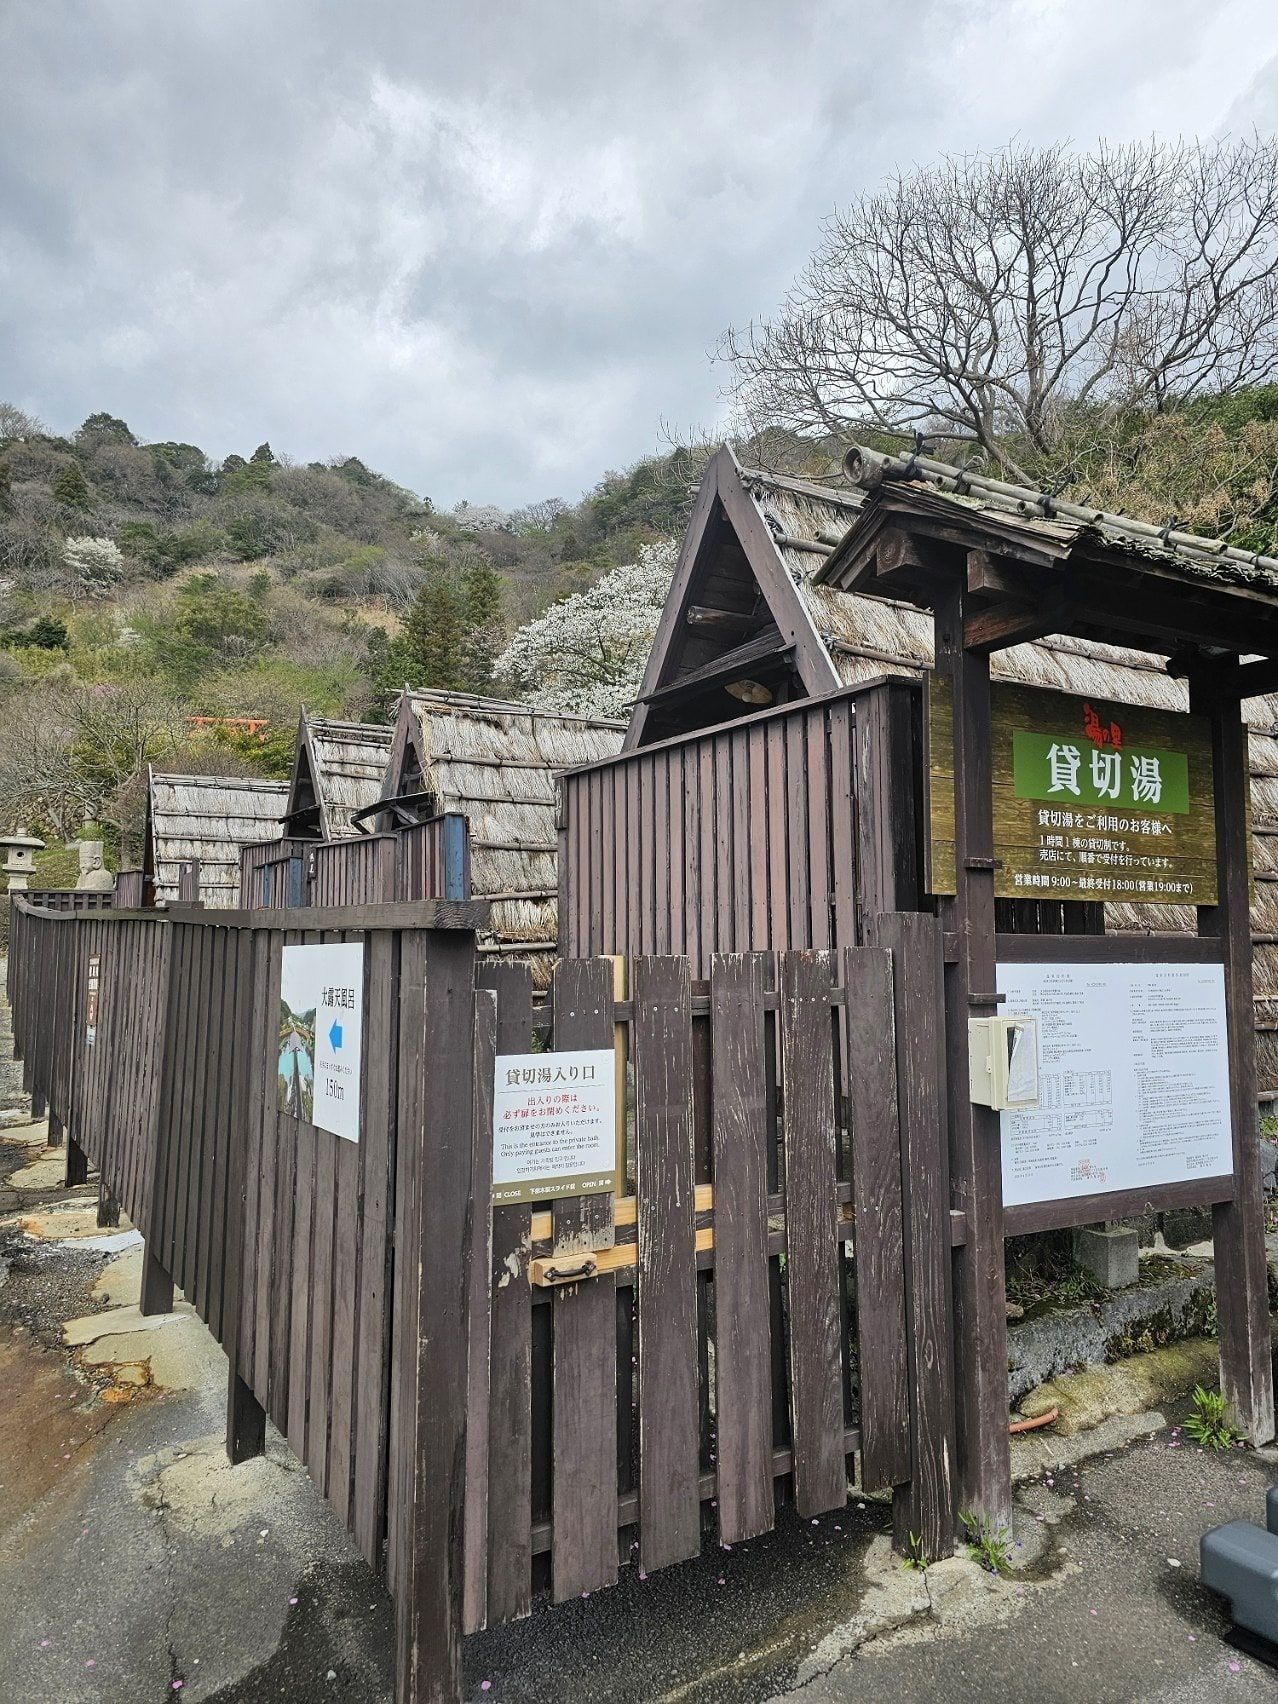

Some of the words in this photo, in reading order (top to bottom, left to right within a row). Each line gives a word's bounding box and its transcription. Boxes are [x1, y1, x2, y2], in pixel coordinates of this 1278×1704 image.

[1045, 743, 1163, 804] 貸切湯
[1037, 809, 1173, 836] 貸切湯をご利用のお客様へ
[321, 986, 355, 1010] 大露天風呂
[505, 1065, 595, 1087] 貸切湯入り口
[326, 1078, 344, 1100] 150m
[527, 1094, 578, 1106] 出入りの際は
[503, 1104, 601, 1120] 必ず扉をお閉めください。
[515, 1149, 533, 1157] paying
[503, 1190, 521, 1198] CLOSE
